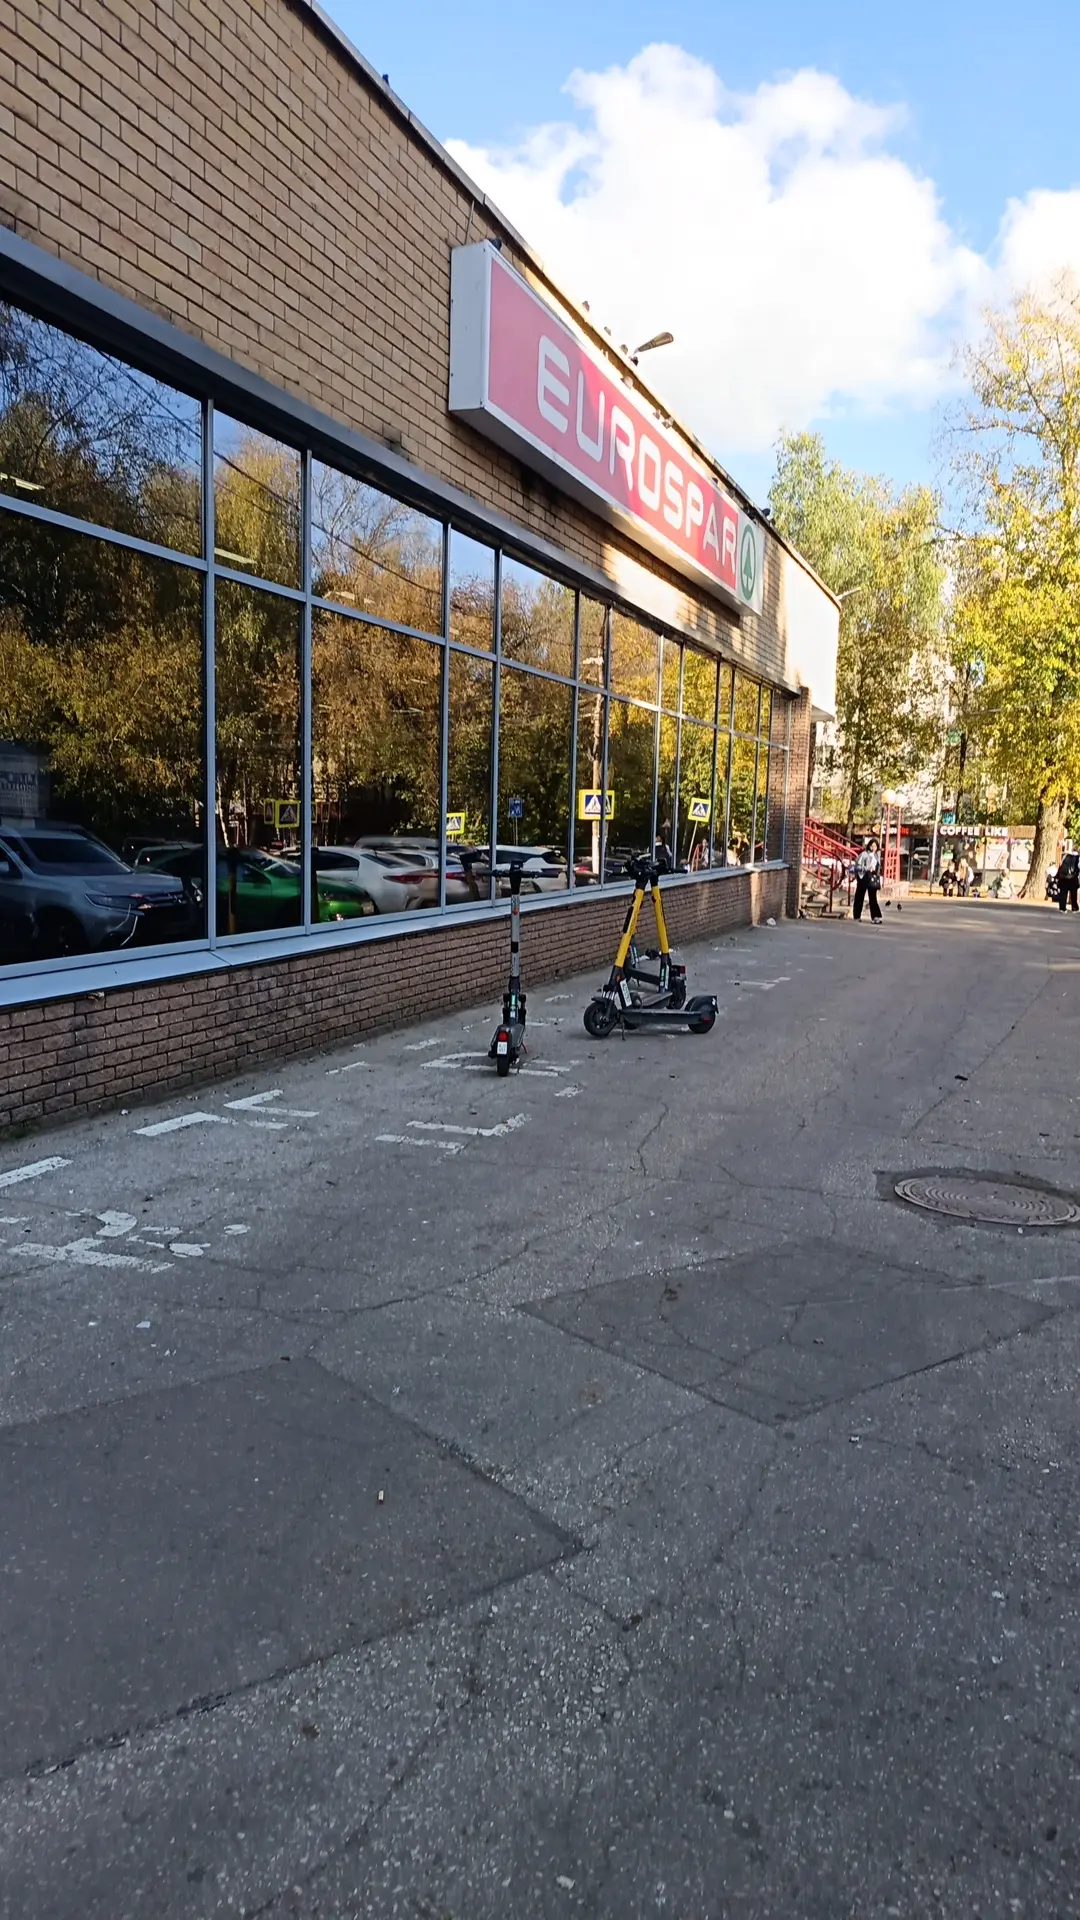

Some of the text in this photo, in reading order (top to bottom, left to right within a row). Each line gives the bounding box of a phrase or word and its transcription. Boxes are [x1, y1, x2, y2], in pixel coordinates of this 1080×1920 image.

[538, 335, 737, 574] EUROSPAR
[939, 825, 1008, 837] COFFEE LIKE
